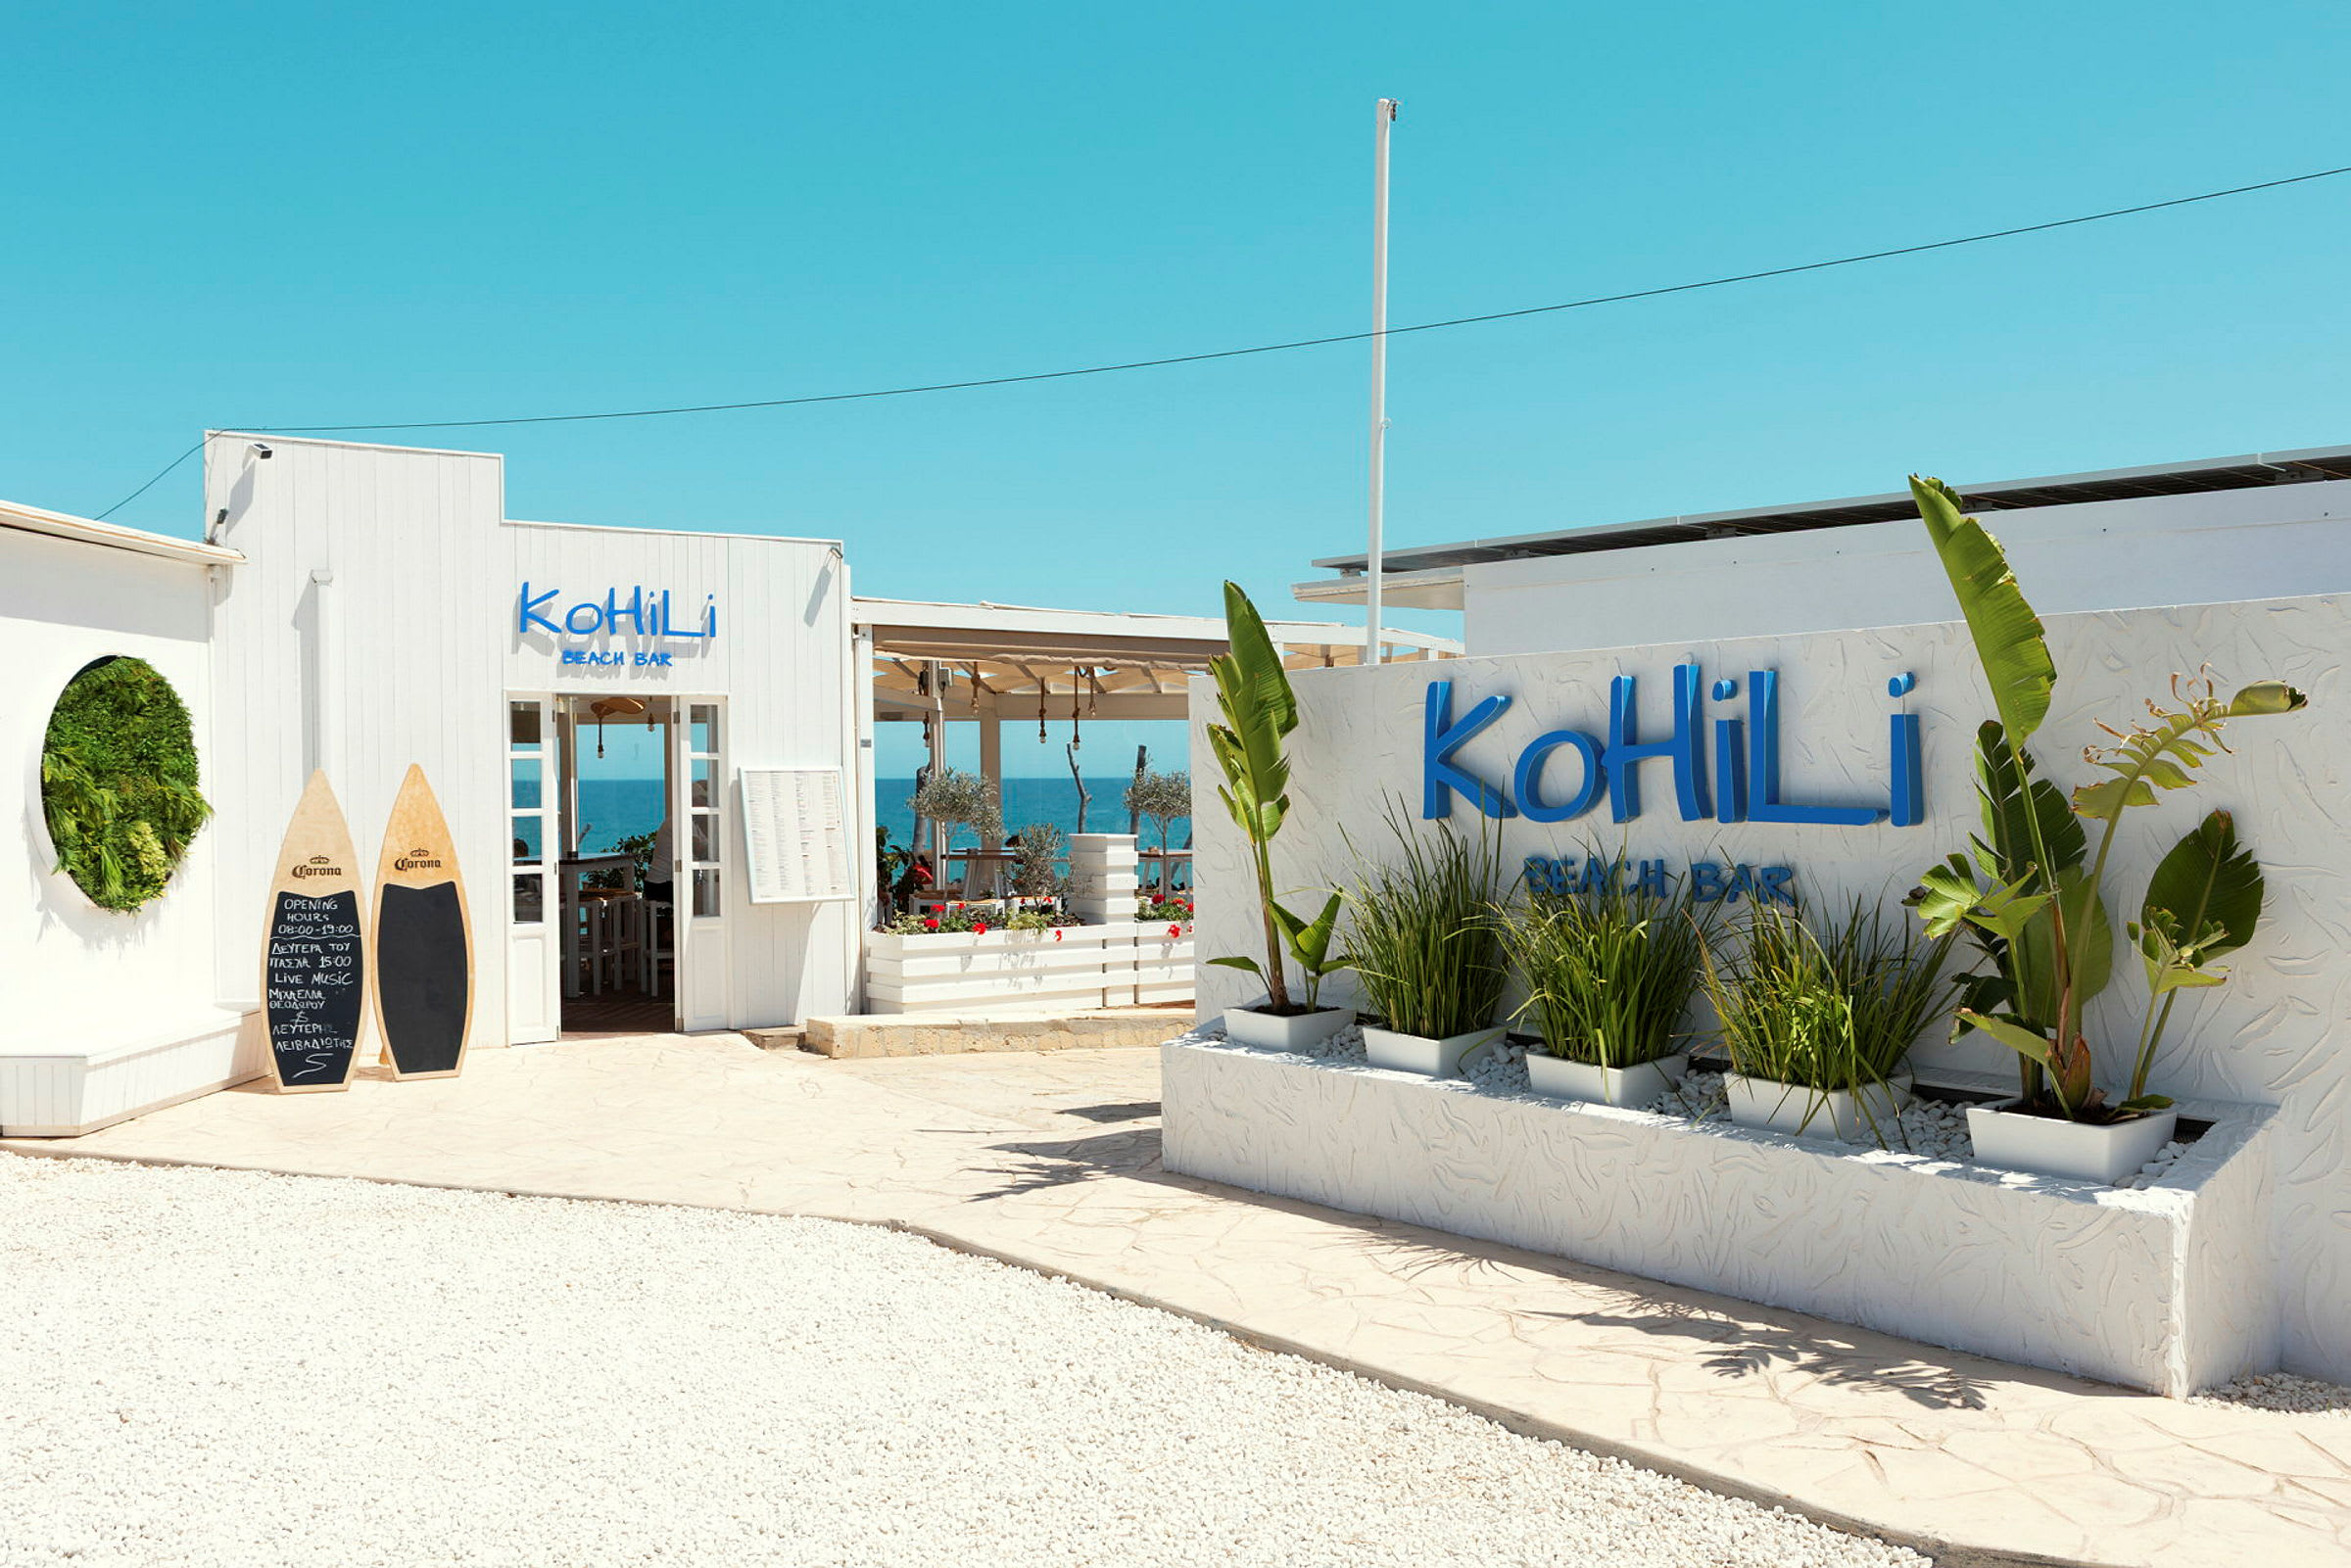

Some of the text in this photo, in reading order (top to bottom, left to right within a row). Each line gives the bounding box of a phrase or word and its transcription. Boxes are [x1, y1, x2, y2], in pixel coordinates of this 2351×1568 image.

[562, 650, 673, 667] BEACH BAR
[292, 865, 342, 879] Corona
[395, 858, 441, 872] Corona
[1524, 857, 1795, 906] BEACH BAR
[284, 898, 338, 910] OPENING
[319, 956, 352, 968] 15:00
